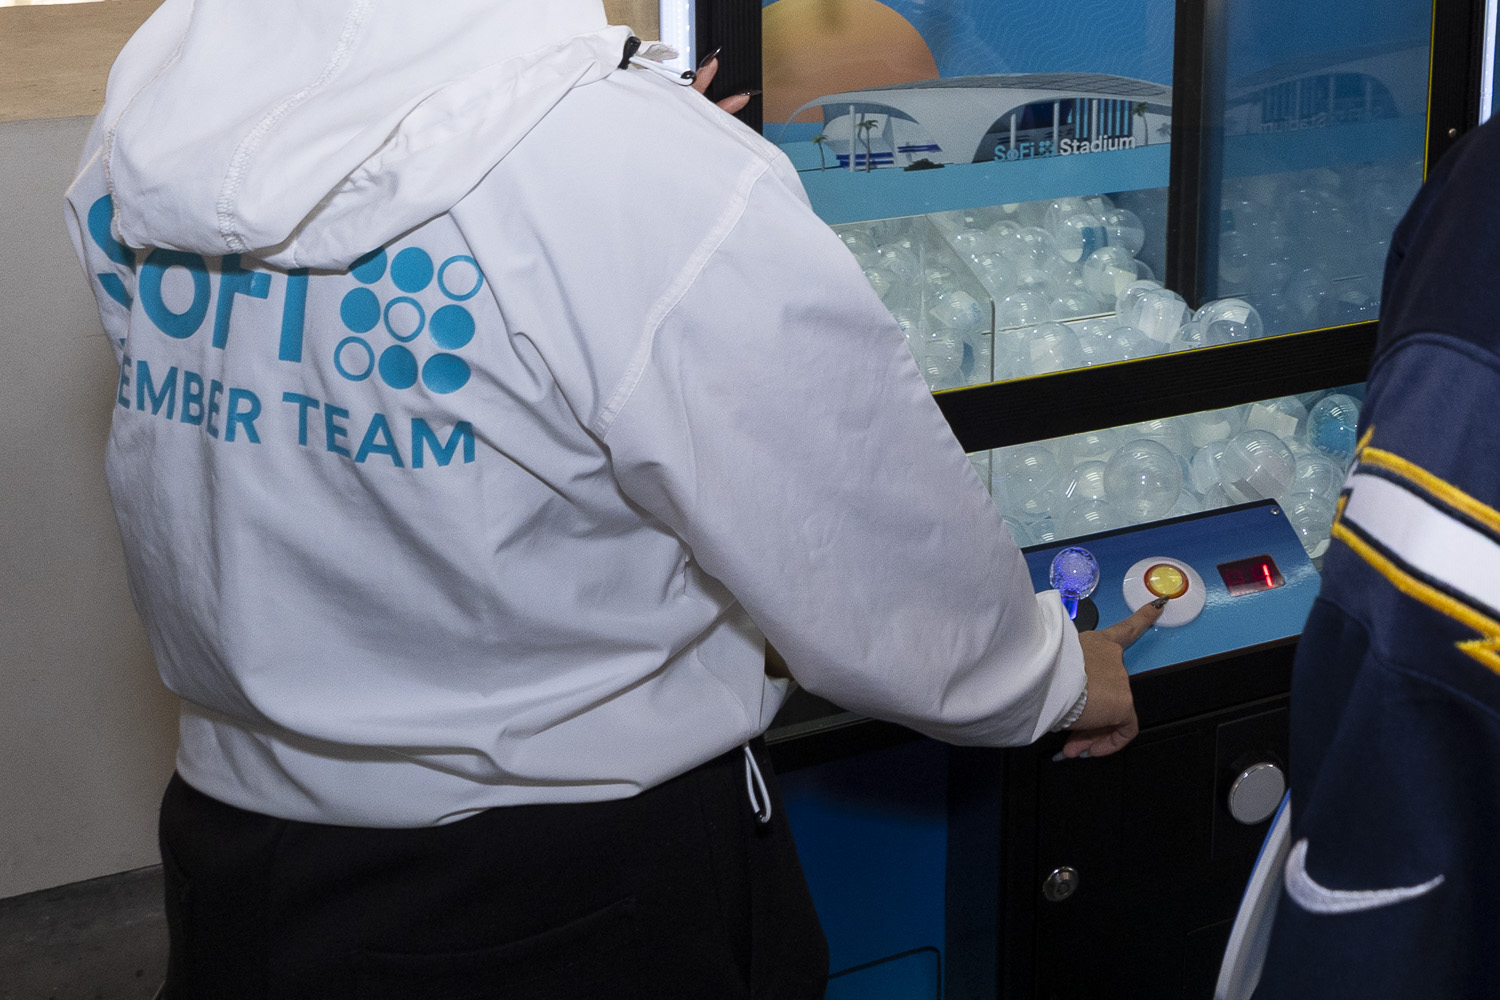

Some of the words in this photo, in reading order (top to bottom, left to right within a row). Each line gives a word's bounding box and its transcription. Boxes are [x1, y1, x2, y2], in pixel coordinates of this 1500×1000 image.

[994, 141, 1035, 162] SoFi
[1060, 134, 1136, 156] Stadium
[118, 352, 261, 444] EMBER
[282, 390, 476, 469] TEAM
